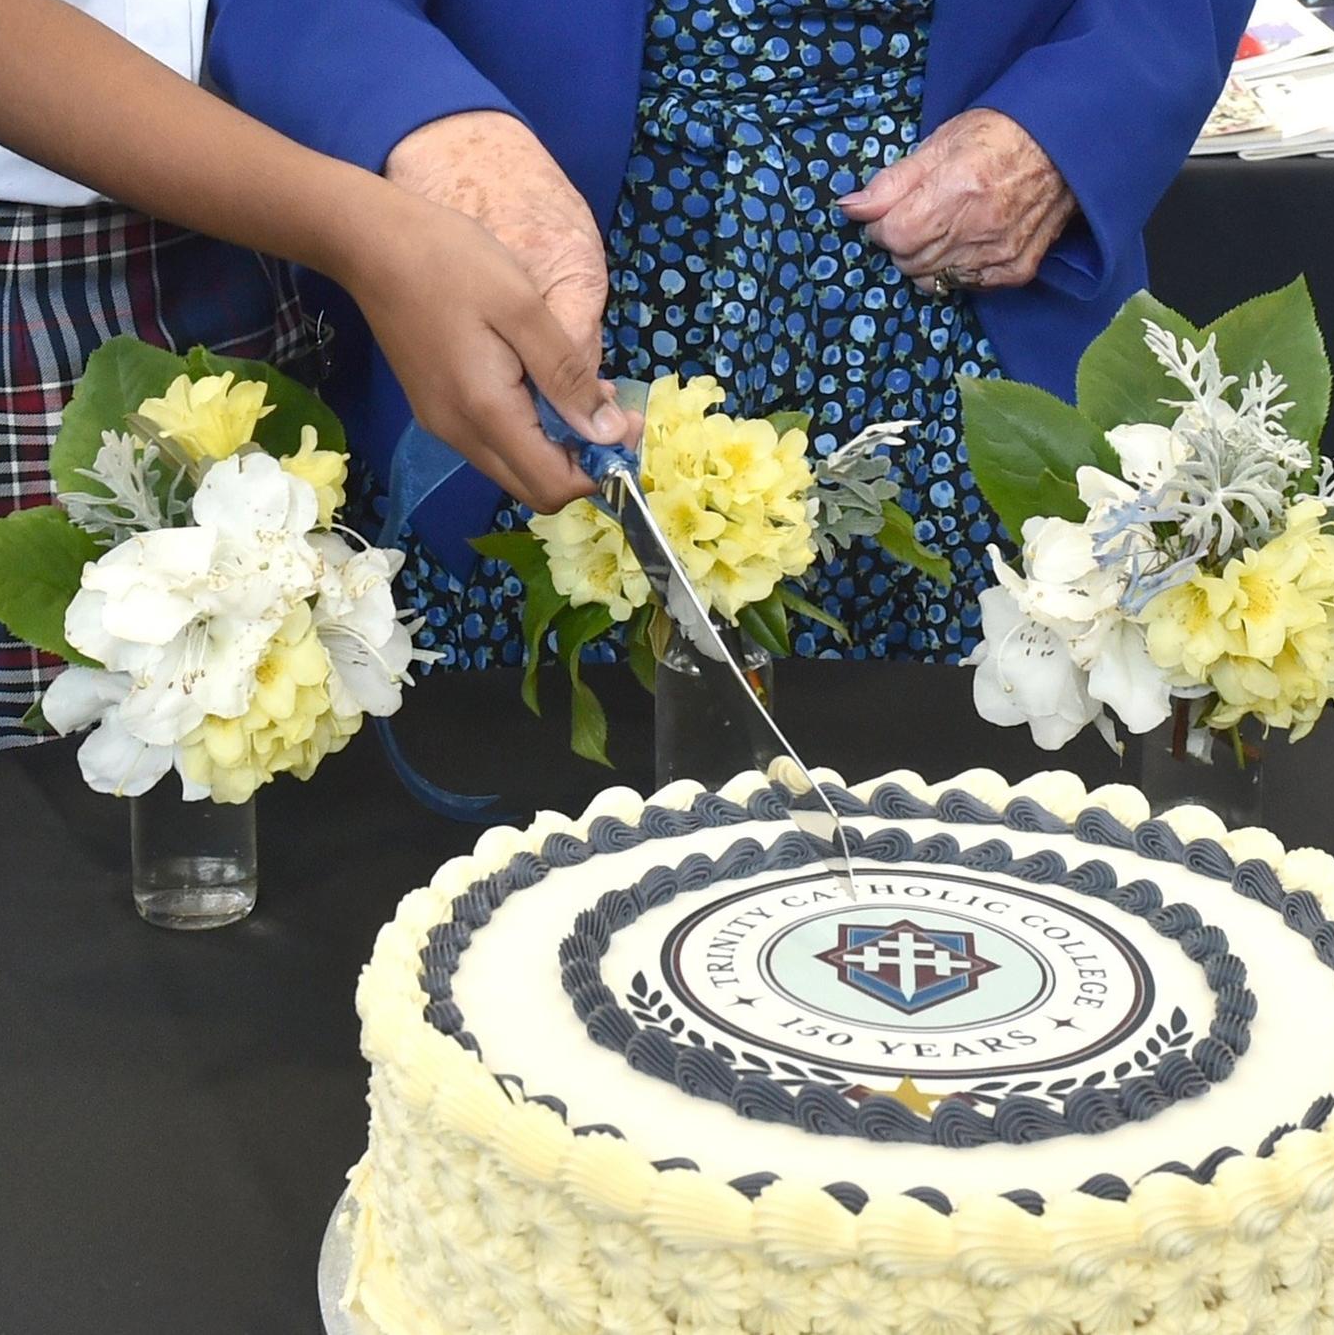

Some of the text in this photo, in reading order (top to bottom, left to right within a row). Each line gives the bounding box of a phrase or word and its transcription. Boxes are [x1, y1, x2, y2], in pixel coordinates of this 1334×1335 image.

[707, 882, 1107, 1010] TRINITY CAHOLIC COLLEGE
[777, 1016, 1039, 1058] 150 YEARS
